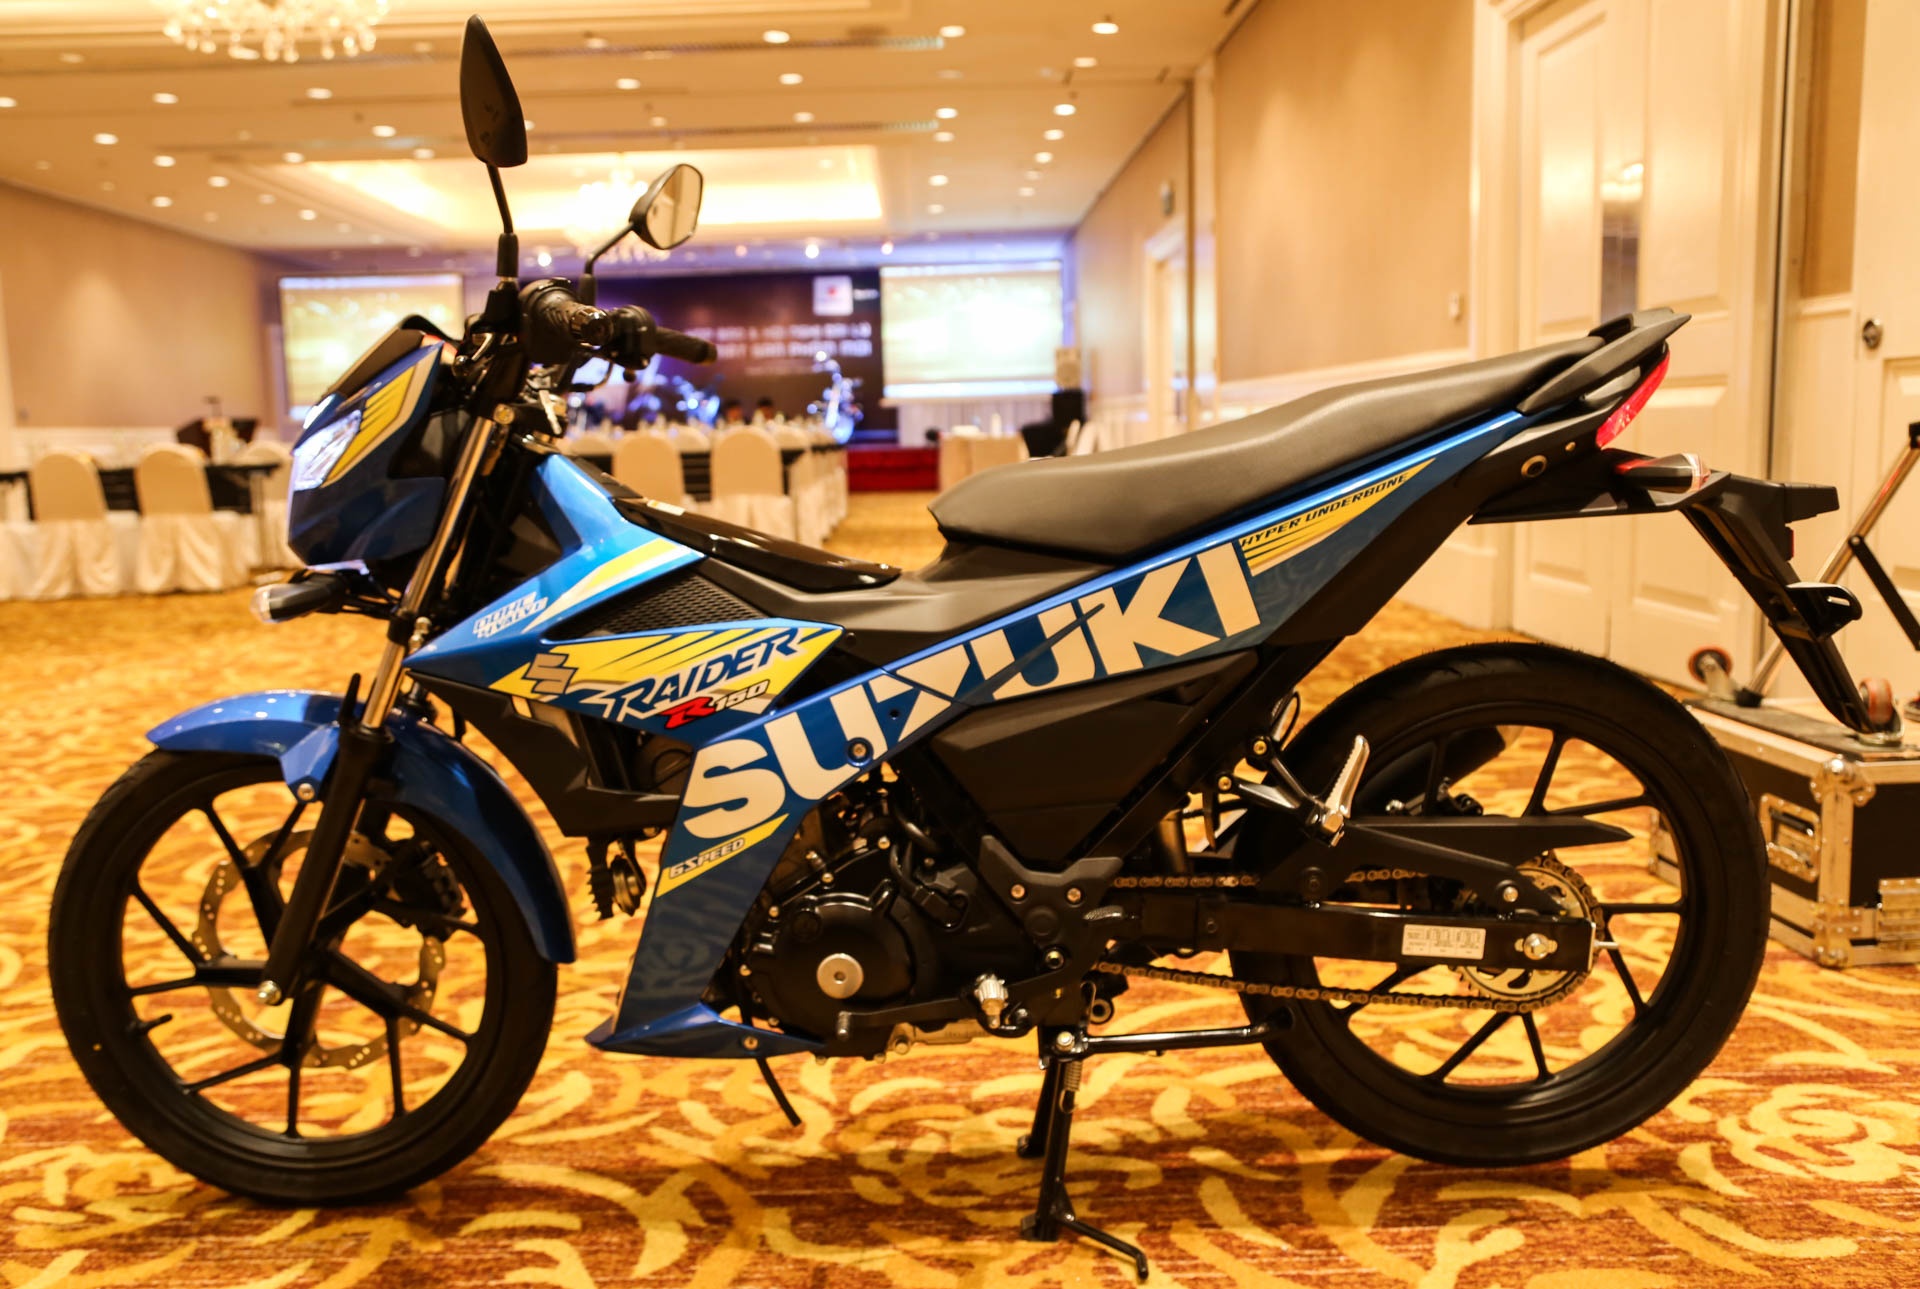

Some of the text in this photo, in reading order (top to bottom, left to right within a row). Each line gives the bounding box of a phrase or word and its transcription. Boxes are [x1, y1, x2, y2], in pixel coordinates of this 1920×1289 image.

[1240, 473, 1408, 547] HYPER UNDERBONE
[602, 627, 799, 722] RAIDER
[682, 542, 1261, 839] SUZUKI
